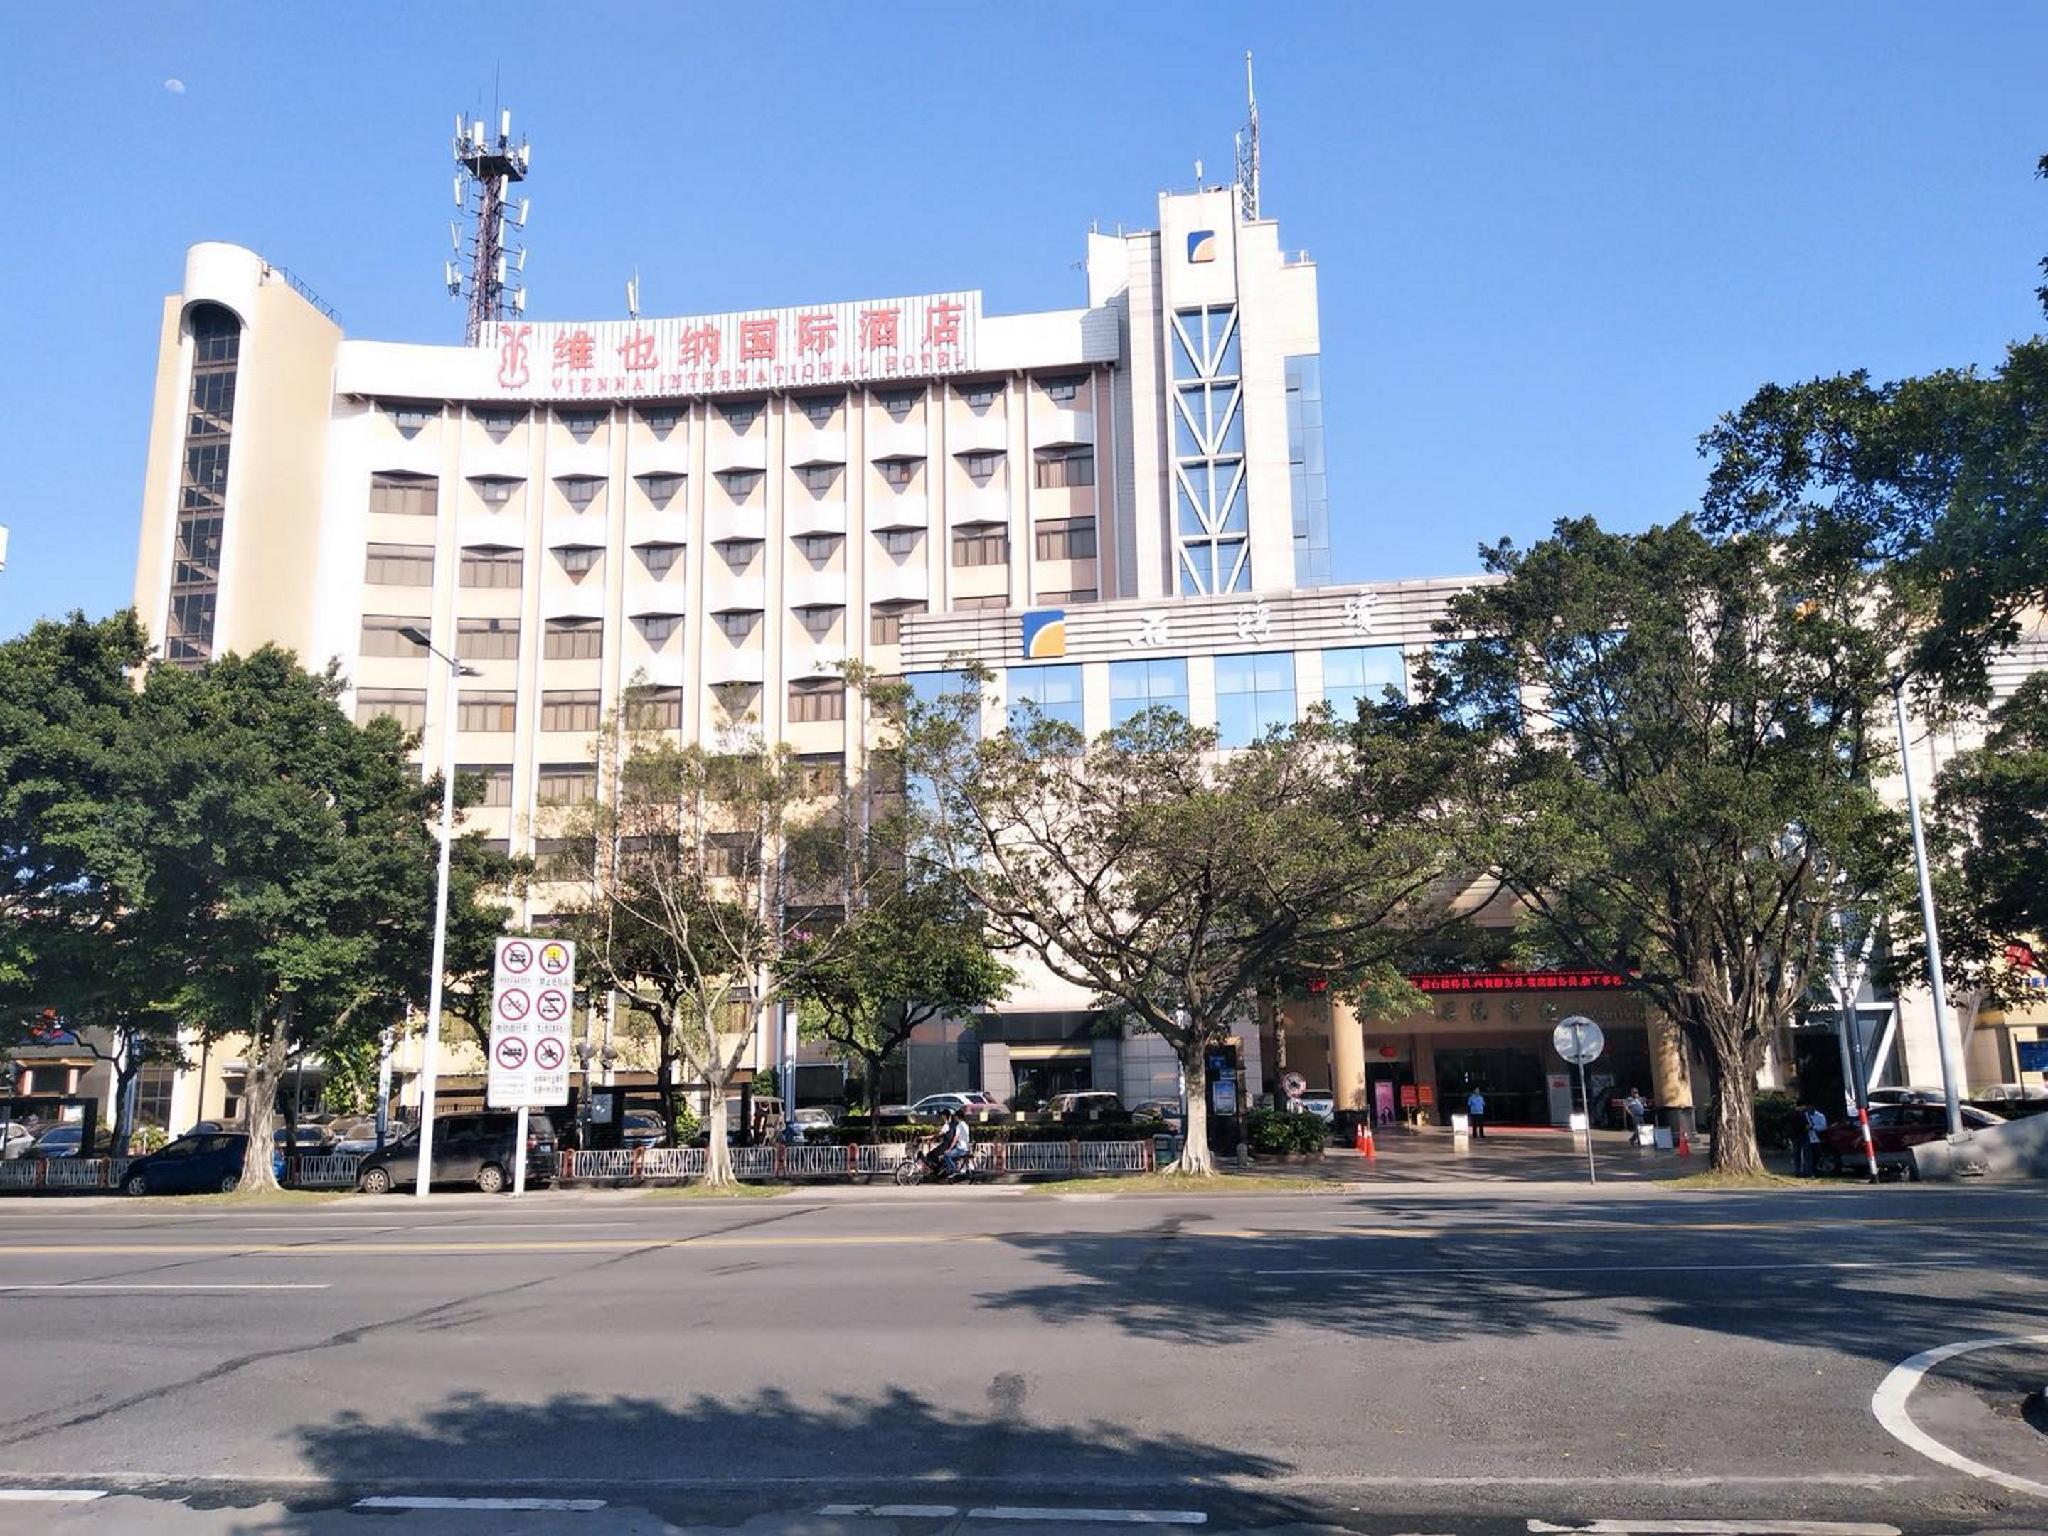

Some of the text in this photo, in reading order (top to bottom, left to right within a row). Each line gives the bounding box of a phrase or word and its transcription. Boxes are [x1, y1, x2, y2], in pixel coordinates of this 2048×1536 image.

[553, 300, 965, 369] 维也纳国际酒店
[551, 349, 966, 395] VIENNA INTERNATIONAL HOTEL
